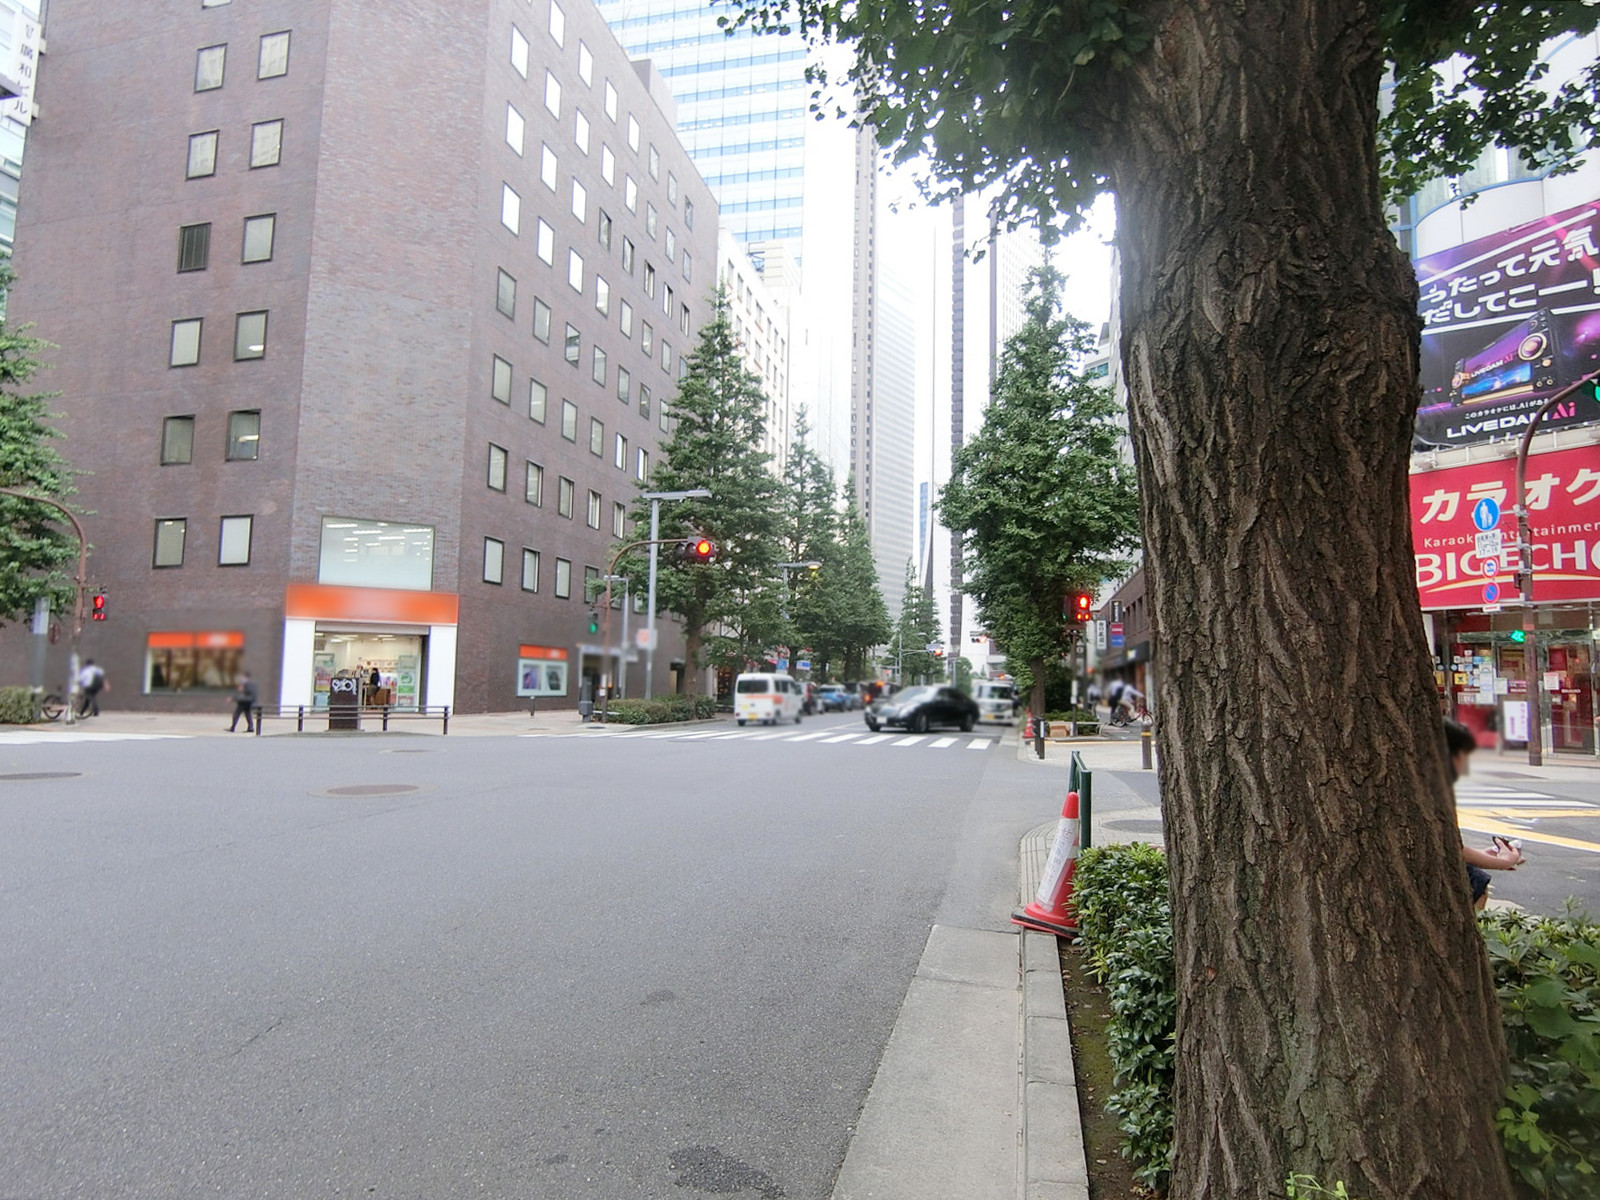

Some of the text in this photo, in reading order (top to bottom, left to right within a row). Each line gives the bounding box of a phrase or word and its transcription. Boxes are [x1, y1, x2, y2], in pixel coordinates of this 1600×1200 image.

[1420, 225, 1599, 303] うたって元気
[1447, 411, 1549, 438] LIVEDAM
[1424, 534, 1474, 548] Karaok
[1499, 539, 1600, 571] ECH
